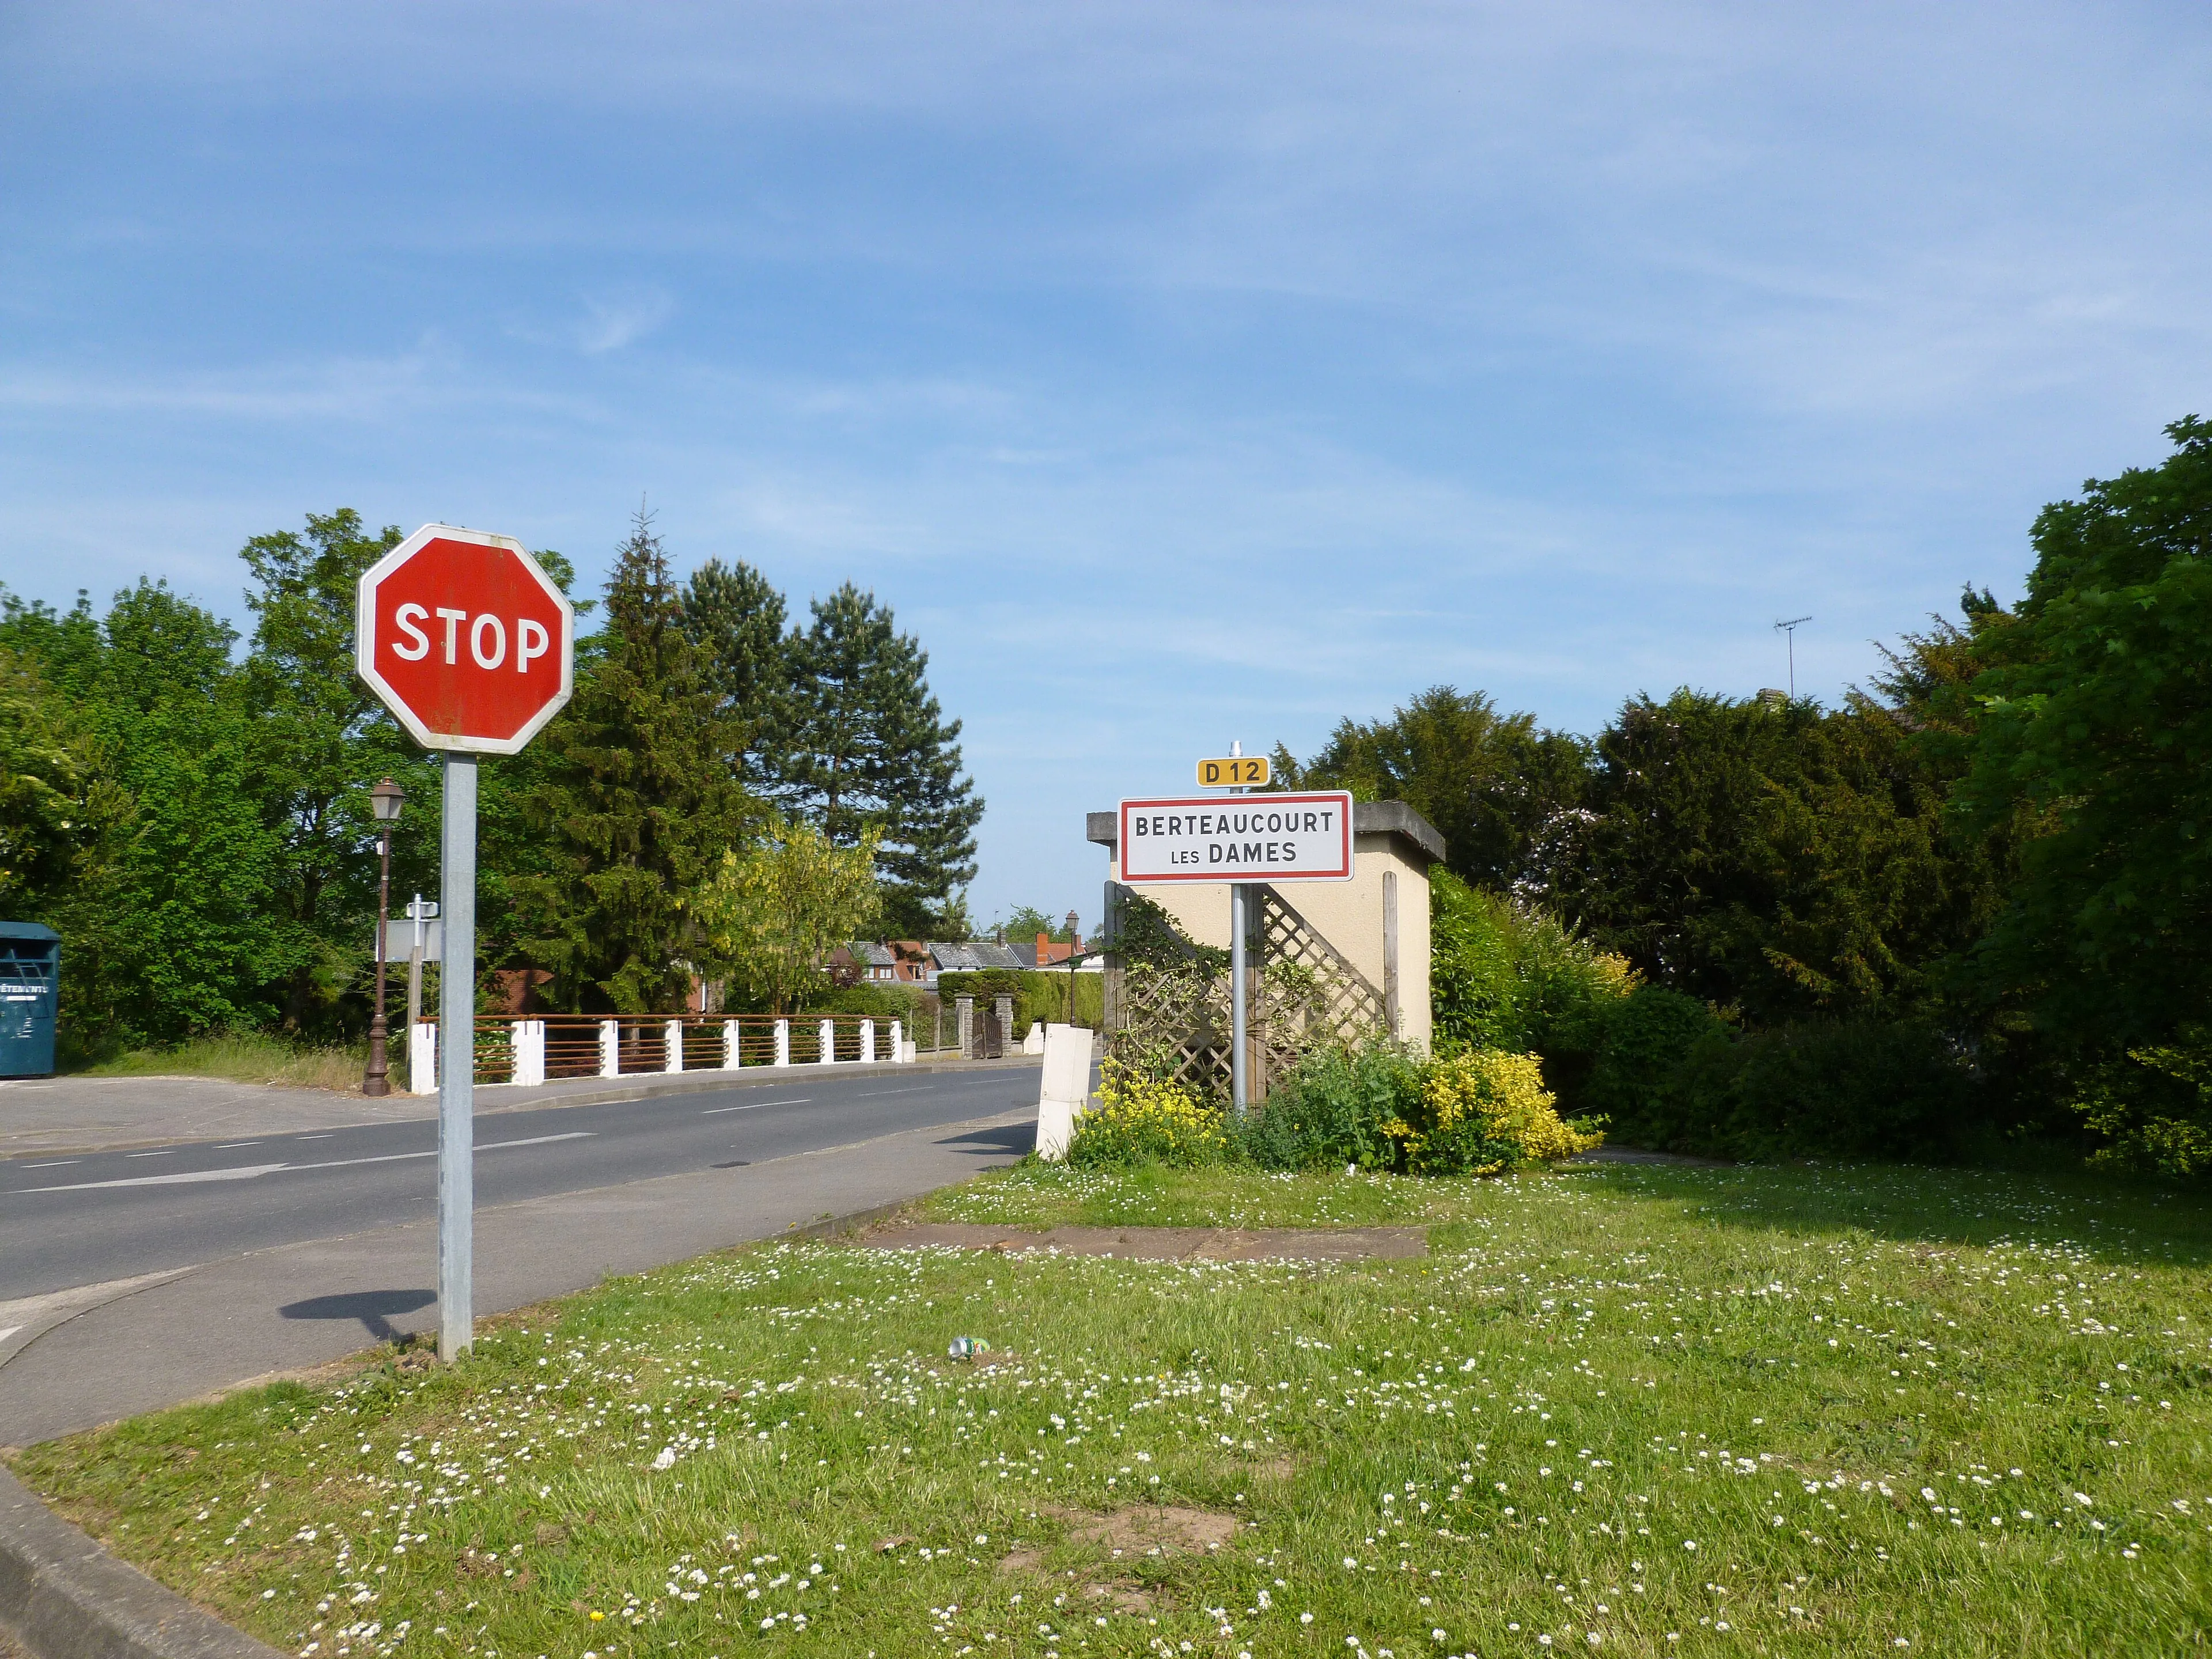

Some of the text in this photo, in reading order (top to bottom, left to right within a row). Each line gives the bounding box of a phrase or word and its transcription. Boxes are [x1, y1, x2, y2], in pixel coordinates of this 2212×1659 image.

[392, 603, 550, 673] STOP
[1206, 761, 1260, 783] D 12
[1135, 811, 1334, 836] BERTEAUCOURT
[1171, 841, 1297, 864] LES DAMES
